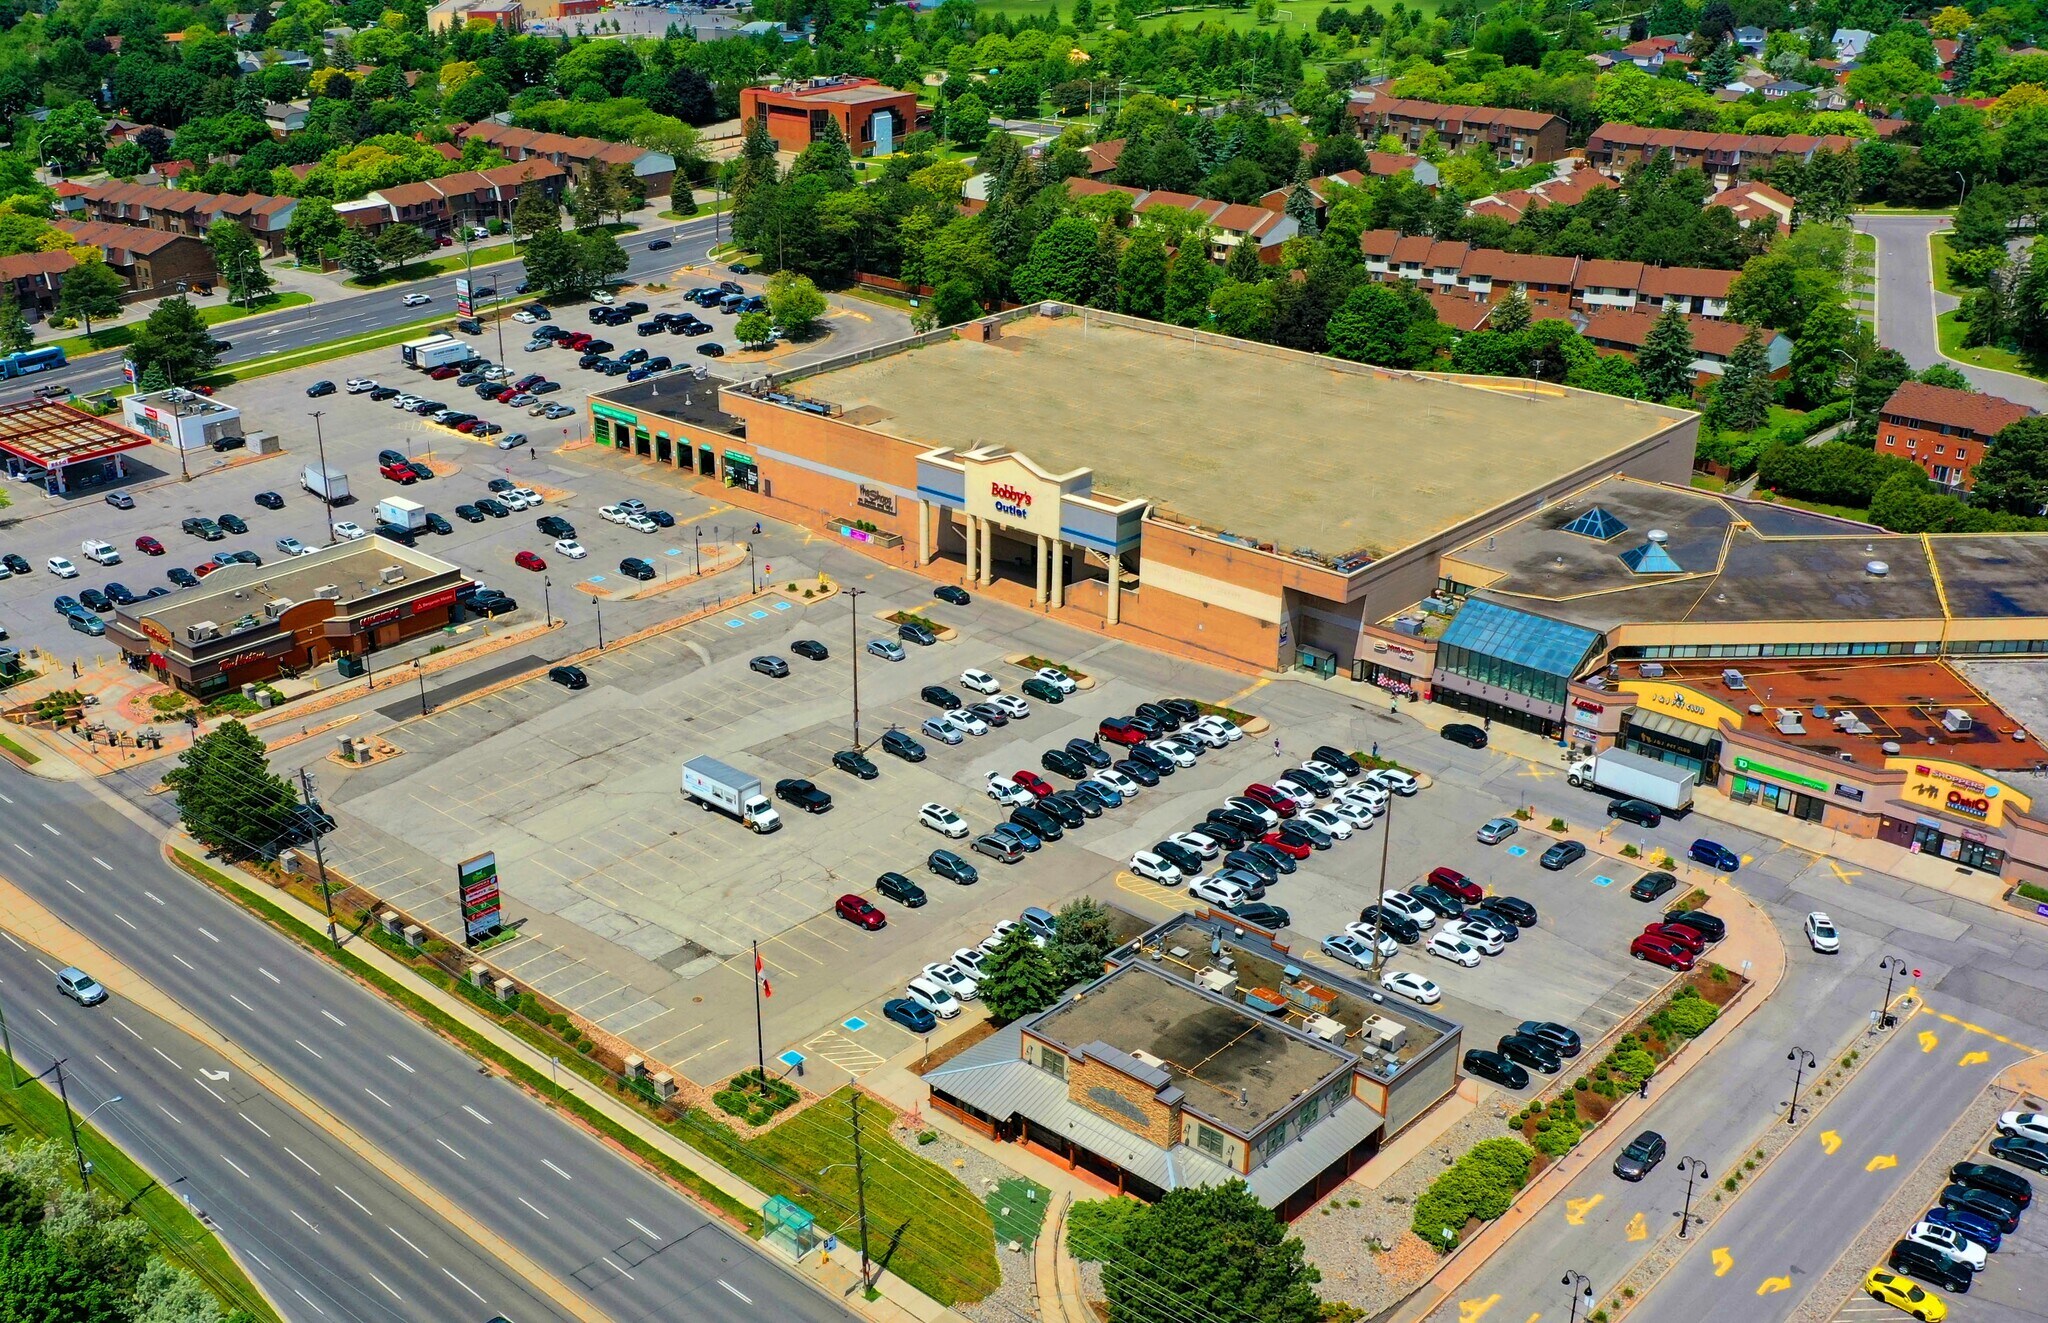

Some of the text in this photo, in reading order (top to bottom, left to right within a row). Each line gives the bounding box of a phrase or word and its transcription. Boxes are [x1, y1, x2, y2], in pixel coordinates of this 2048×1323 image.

[992, 482, 1031, 507] Bobby's
[995, 501, 1027, 519] Outlet
[1686, 703, 1706, 715] CLUB
[1738, 760, 1748, 768] TD
[1932, 770, 1985, 789] SHOPPERS
[1947, 802, 1985, 817] RESTAURANT
